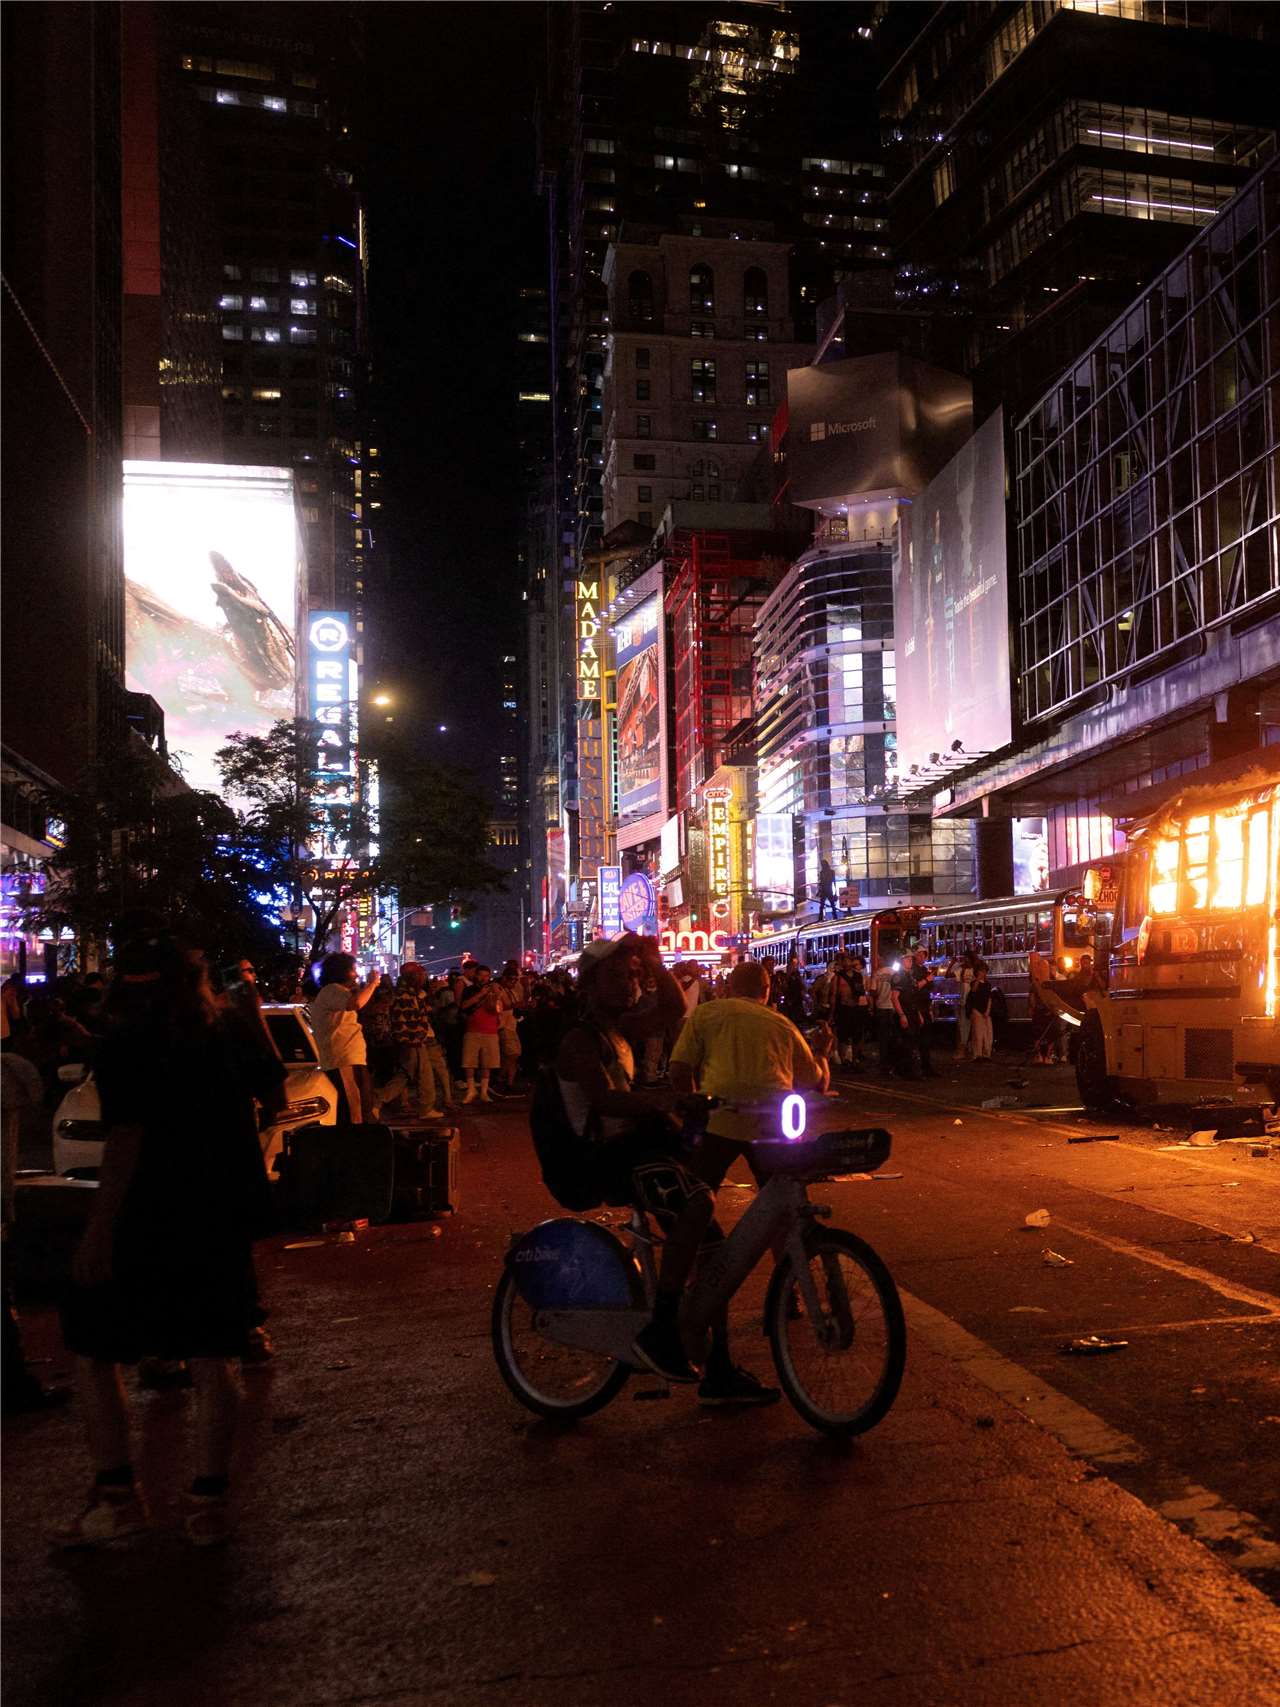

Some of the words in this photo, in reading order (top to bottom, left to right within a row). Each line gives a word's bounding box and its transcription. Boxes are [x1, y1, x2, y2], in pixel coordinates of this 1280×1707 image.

[828, 417, 876, 435] Microsoft
[578, 581, 600, 698] MADAME
[315, 660, 343, 770] REGAL
[706, 789, 728, 798] amc
[713, 807, 727, 896] EMPIRE
[658, 930, 729, 952] amc
